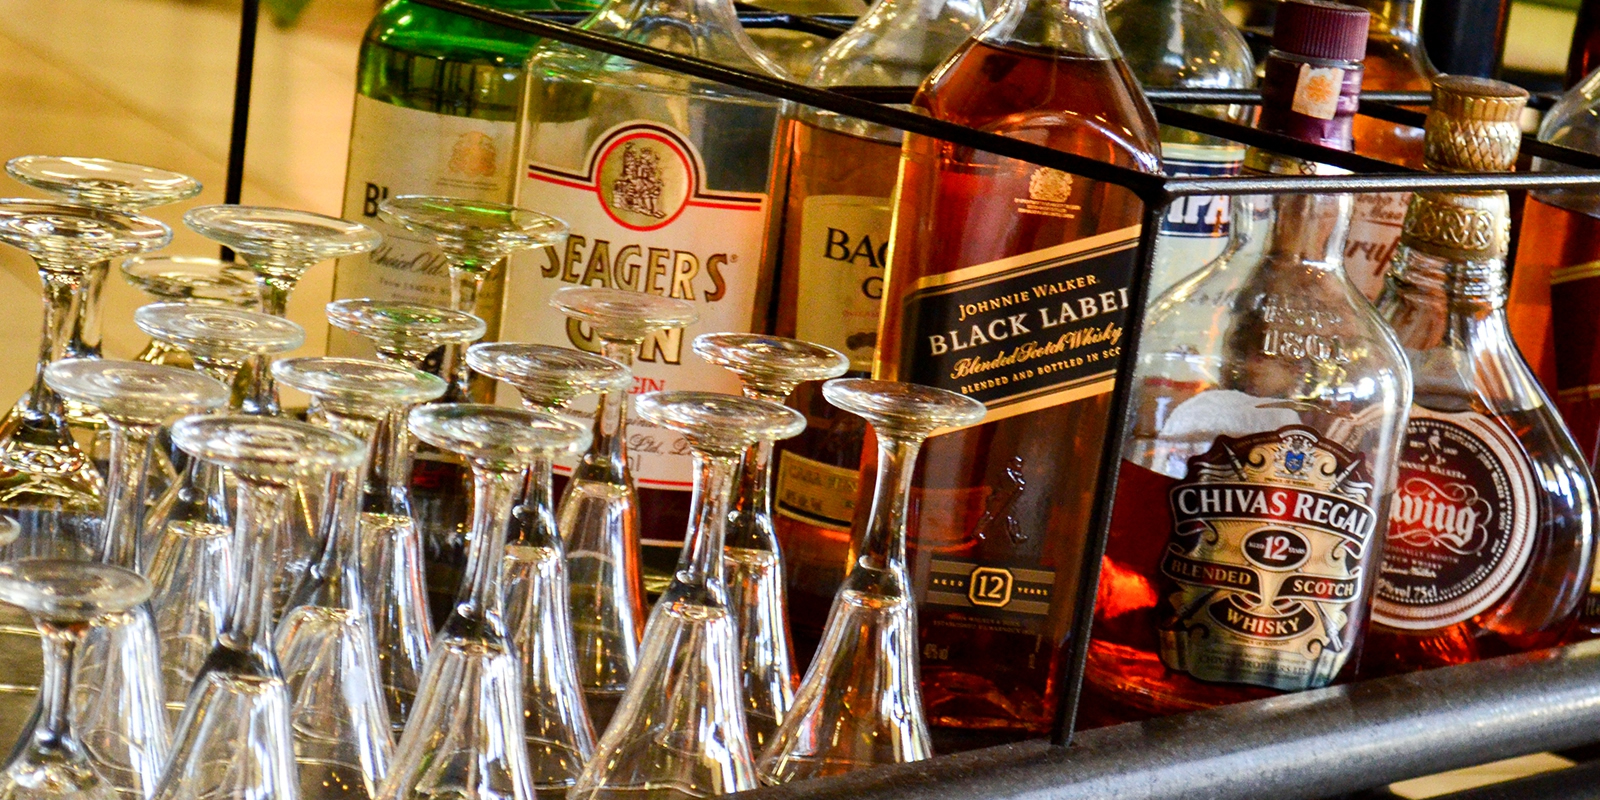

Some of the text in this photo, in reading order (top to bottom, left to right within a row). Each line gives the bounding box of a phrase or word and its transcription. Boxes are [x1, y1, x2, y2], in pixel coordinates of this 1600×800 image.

[540, 234, 728, 303] SEAGERS
[958, 274, 1098, 322] JOHNNIE WALKER
[928, 312, 1031, 357] BLACK
[950, 321, 1124, 381] Blended Scotch Whisky
[960, 374, 1010, 396] BLENDED
[1012, 368, 1034, 384] AND
[1037, 356, 1085, 377] BOTTLED
[1087, 353, 1100, 364] IN
[1178, 488, 1370, 540] CHIVAS REGAL
[1262, 535, 1290, 561] 12
[933, 574, 1049, 599] AGED 12 YEARS
[1171, 557, 1355, 598] BLENDED SCOTCH
[1225, 607, 1301, 635] WHISKY
